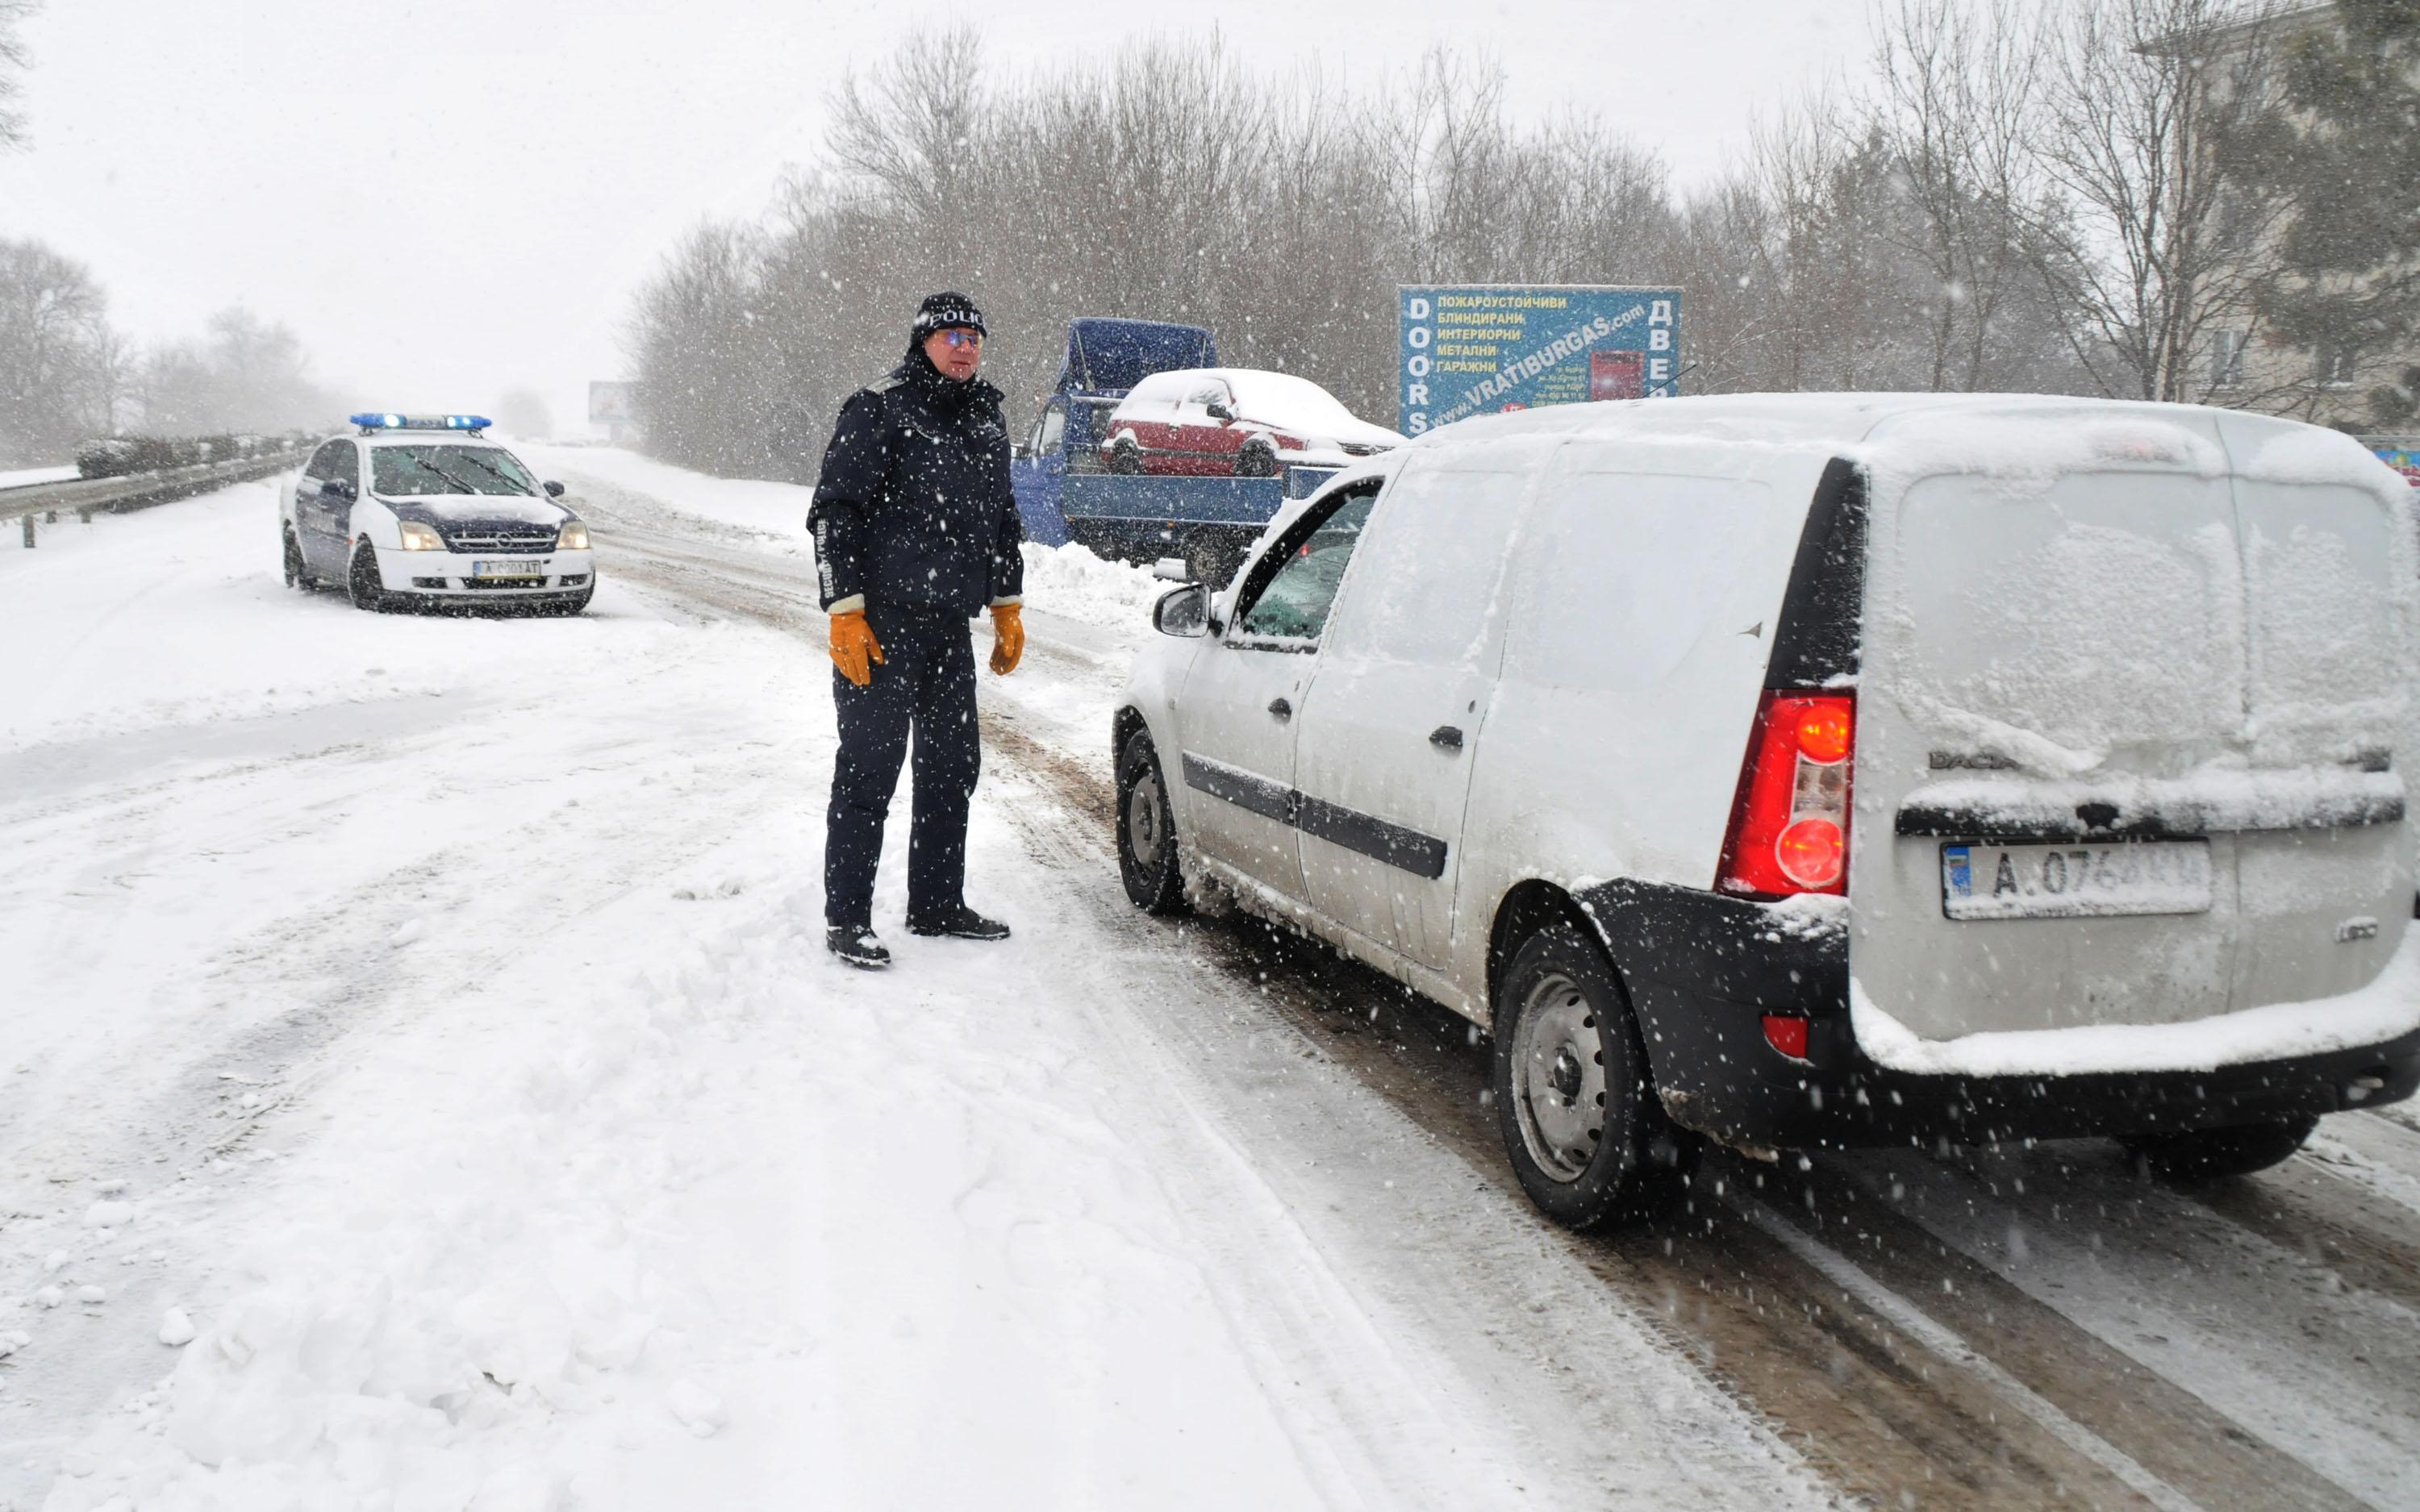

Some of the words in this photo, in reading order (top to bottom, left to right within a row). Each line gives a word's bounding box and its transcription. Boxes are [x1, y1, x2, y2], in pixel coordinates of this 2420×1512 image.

[1437, 296, 1567, 309] ПОЖАРОУСТОЙЧИВИ
[928, 310, 986, 328] POLIC
[1437, 312, 1524, 324] БЛИНДИРАНИ
[1437, 328, 1521, 340] ИНТЕРИОРНИ
[1437, 345, 1497, 356] МЕТАЛНИ
[1436, 360, 1498, 373] ГАРАЖНИ
